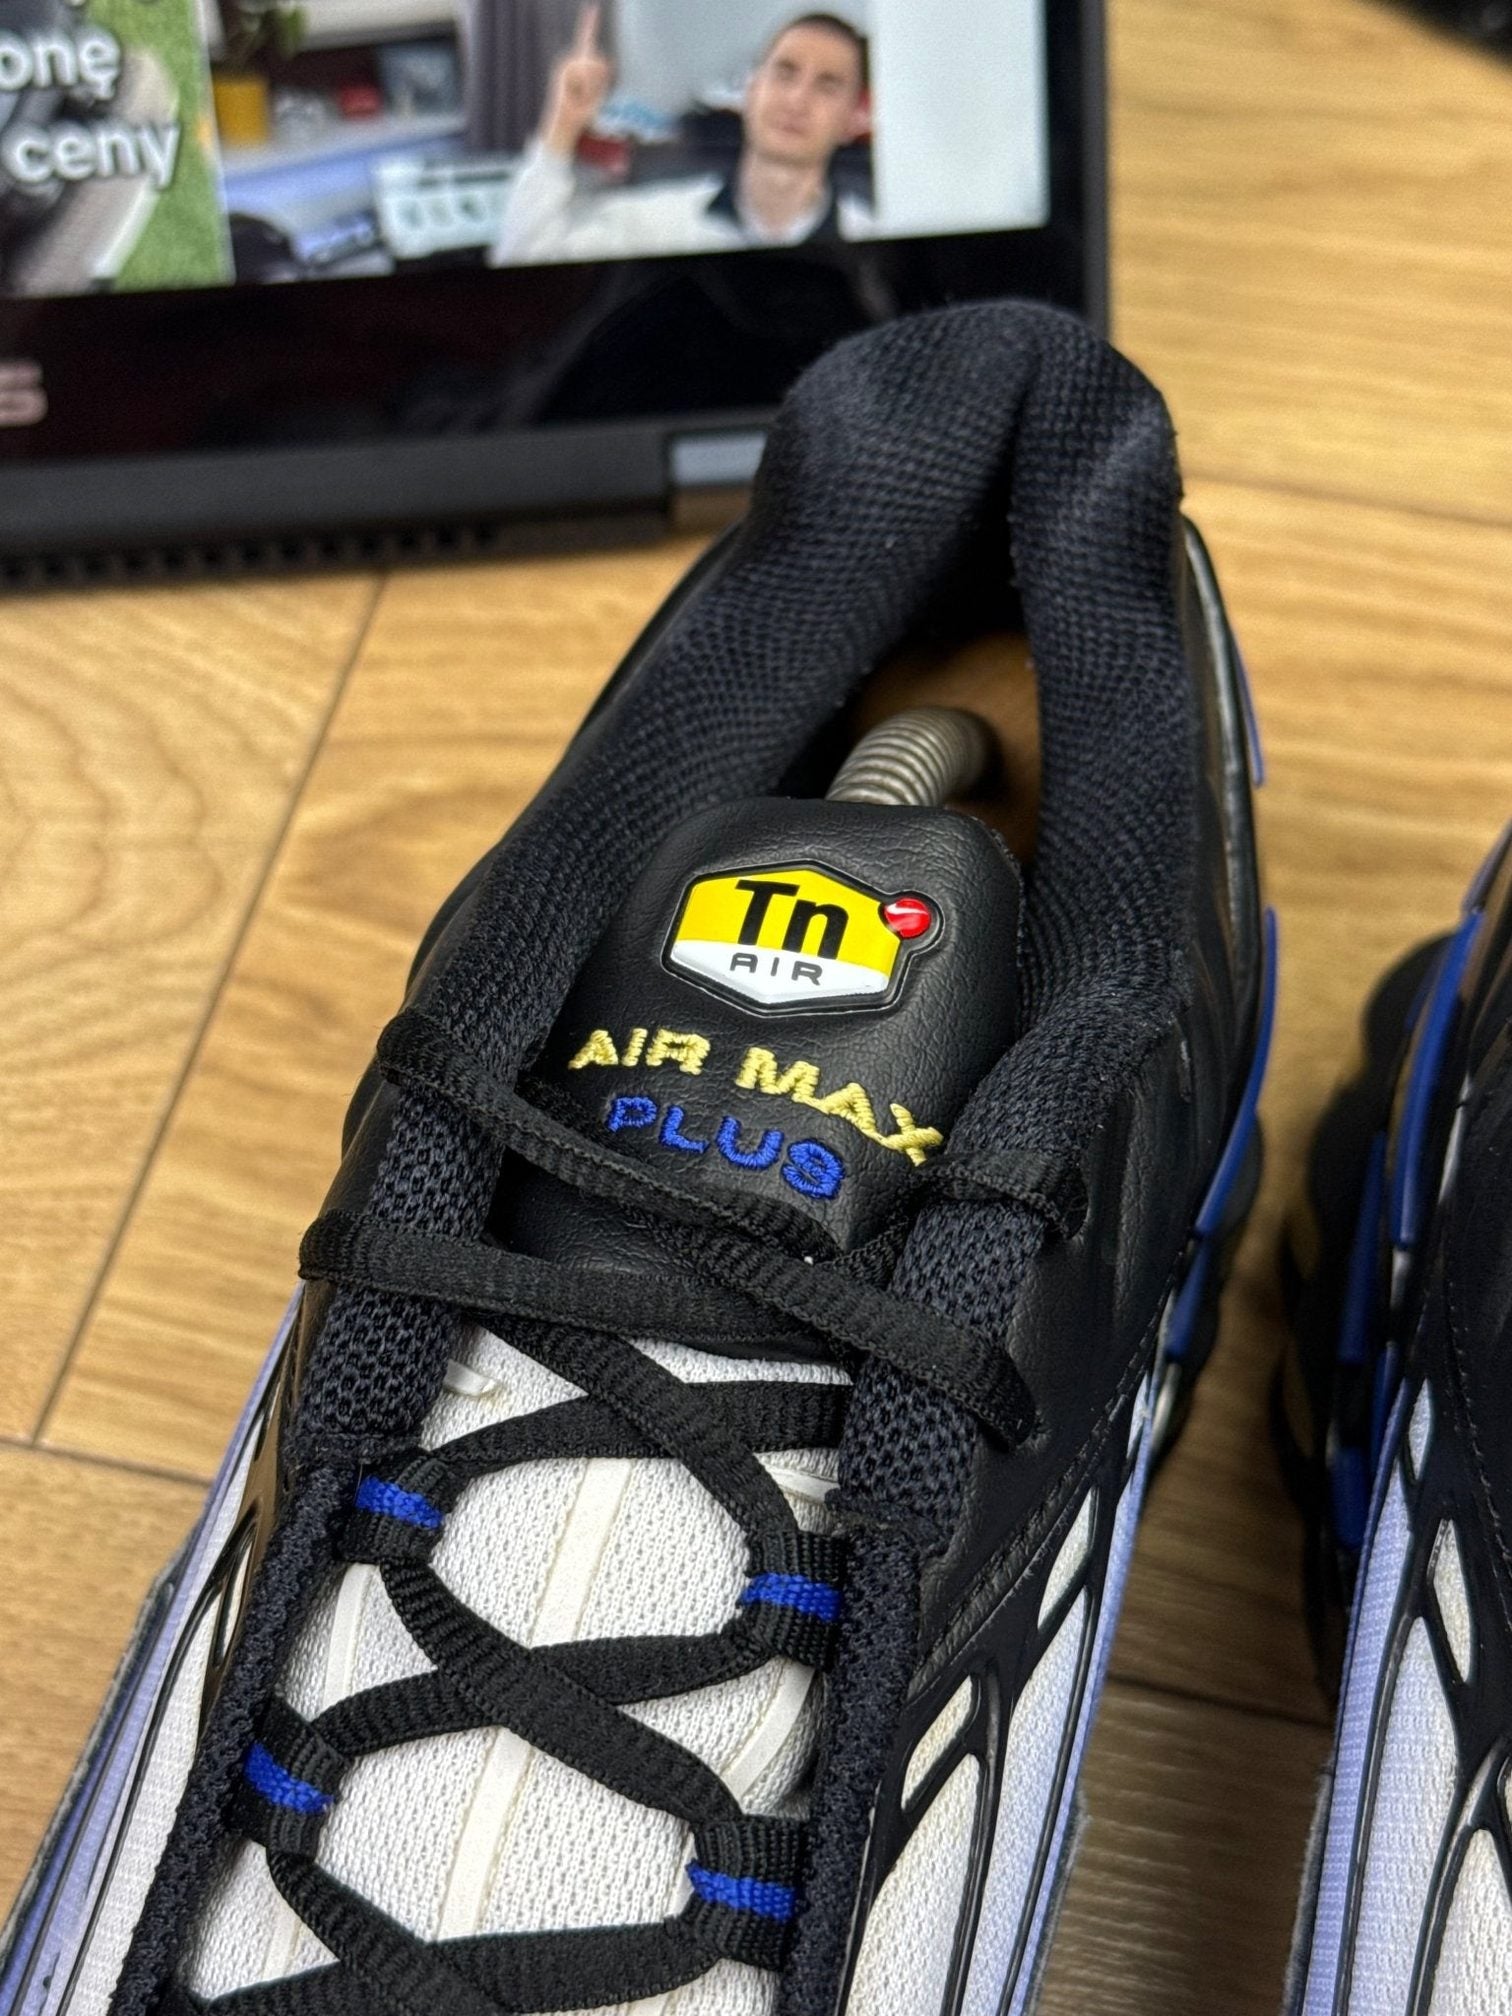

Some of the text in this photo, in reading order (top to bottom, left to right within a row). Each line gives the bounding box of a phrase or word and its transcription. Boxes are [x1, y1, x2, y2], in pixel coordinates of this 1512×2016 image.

[14, 122, 178, 188] ceny
[735, 879, 849, 960] Tn
[729, 952, 823, 986] AIR
[568, 1027, 944, 1167] AIR MAX
[606, 1095, 846, 1200] PLUS
